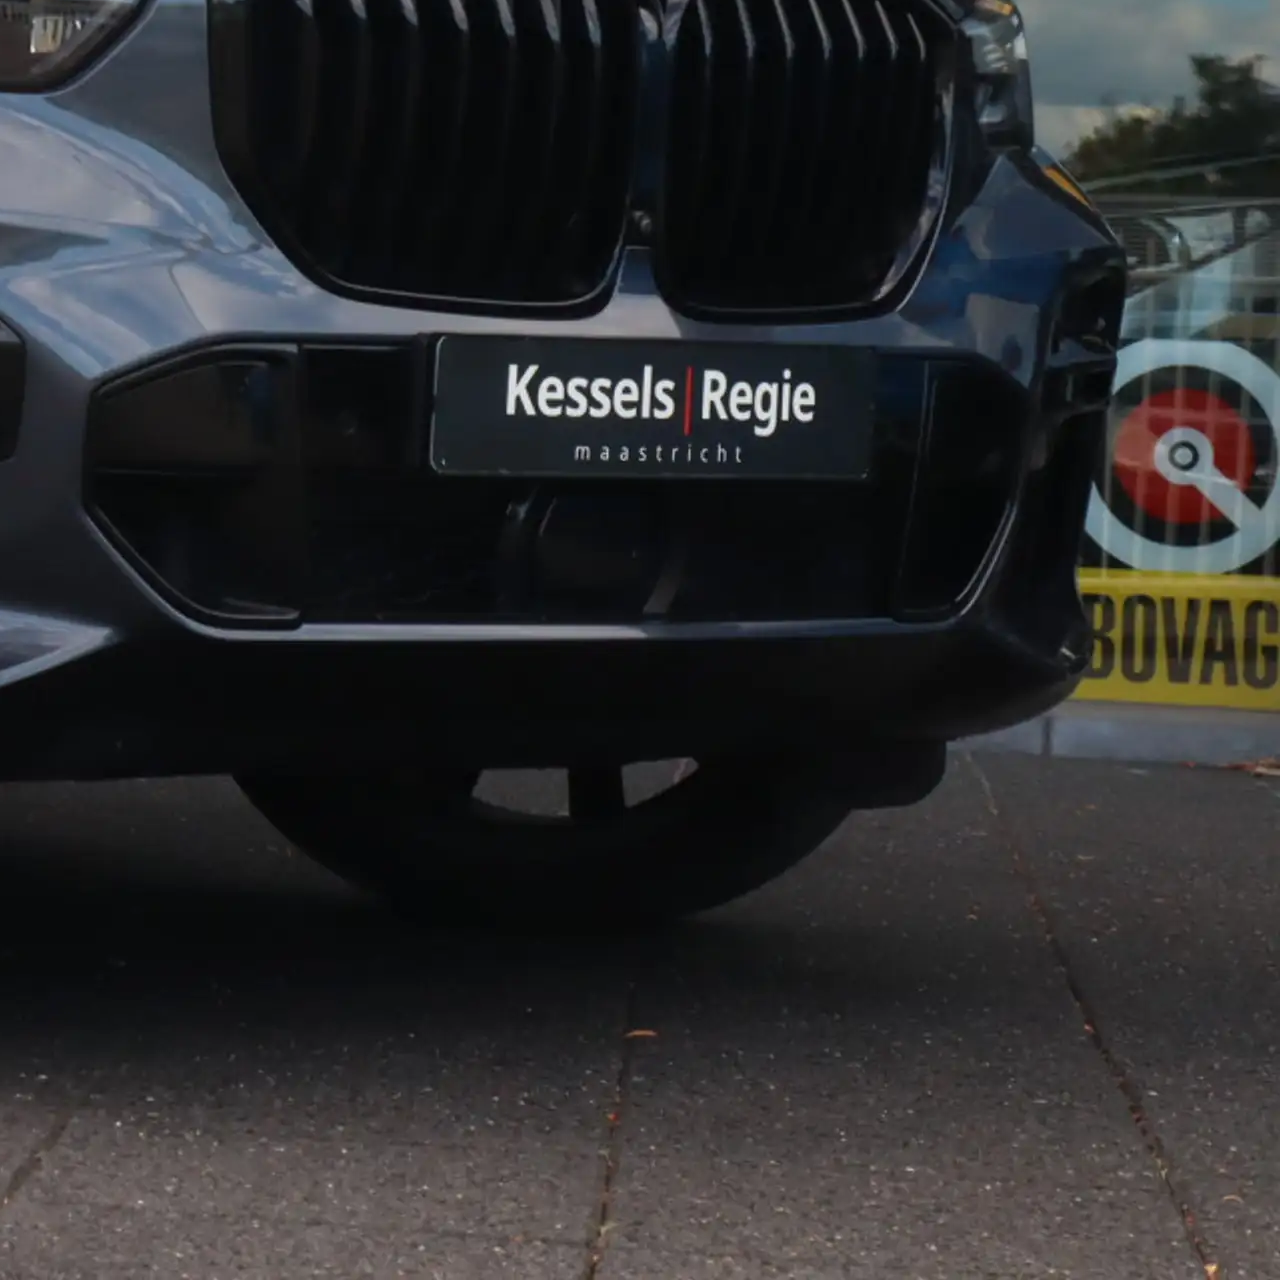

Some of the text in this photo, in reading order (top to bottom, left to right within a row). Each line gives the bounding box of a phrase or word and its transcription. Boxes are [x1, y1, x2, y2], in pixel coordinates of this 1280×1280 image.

[506, 363, 817, 437] Kessels Regie
[574, 443, 743, 464] maastricht
[1081, 592, 1279, 690] BOVAG
